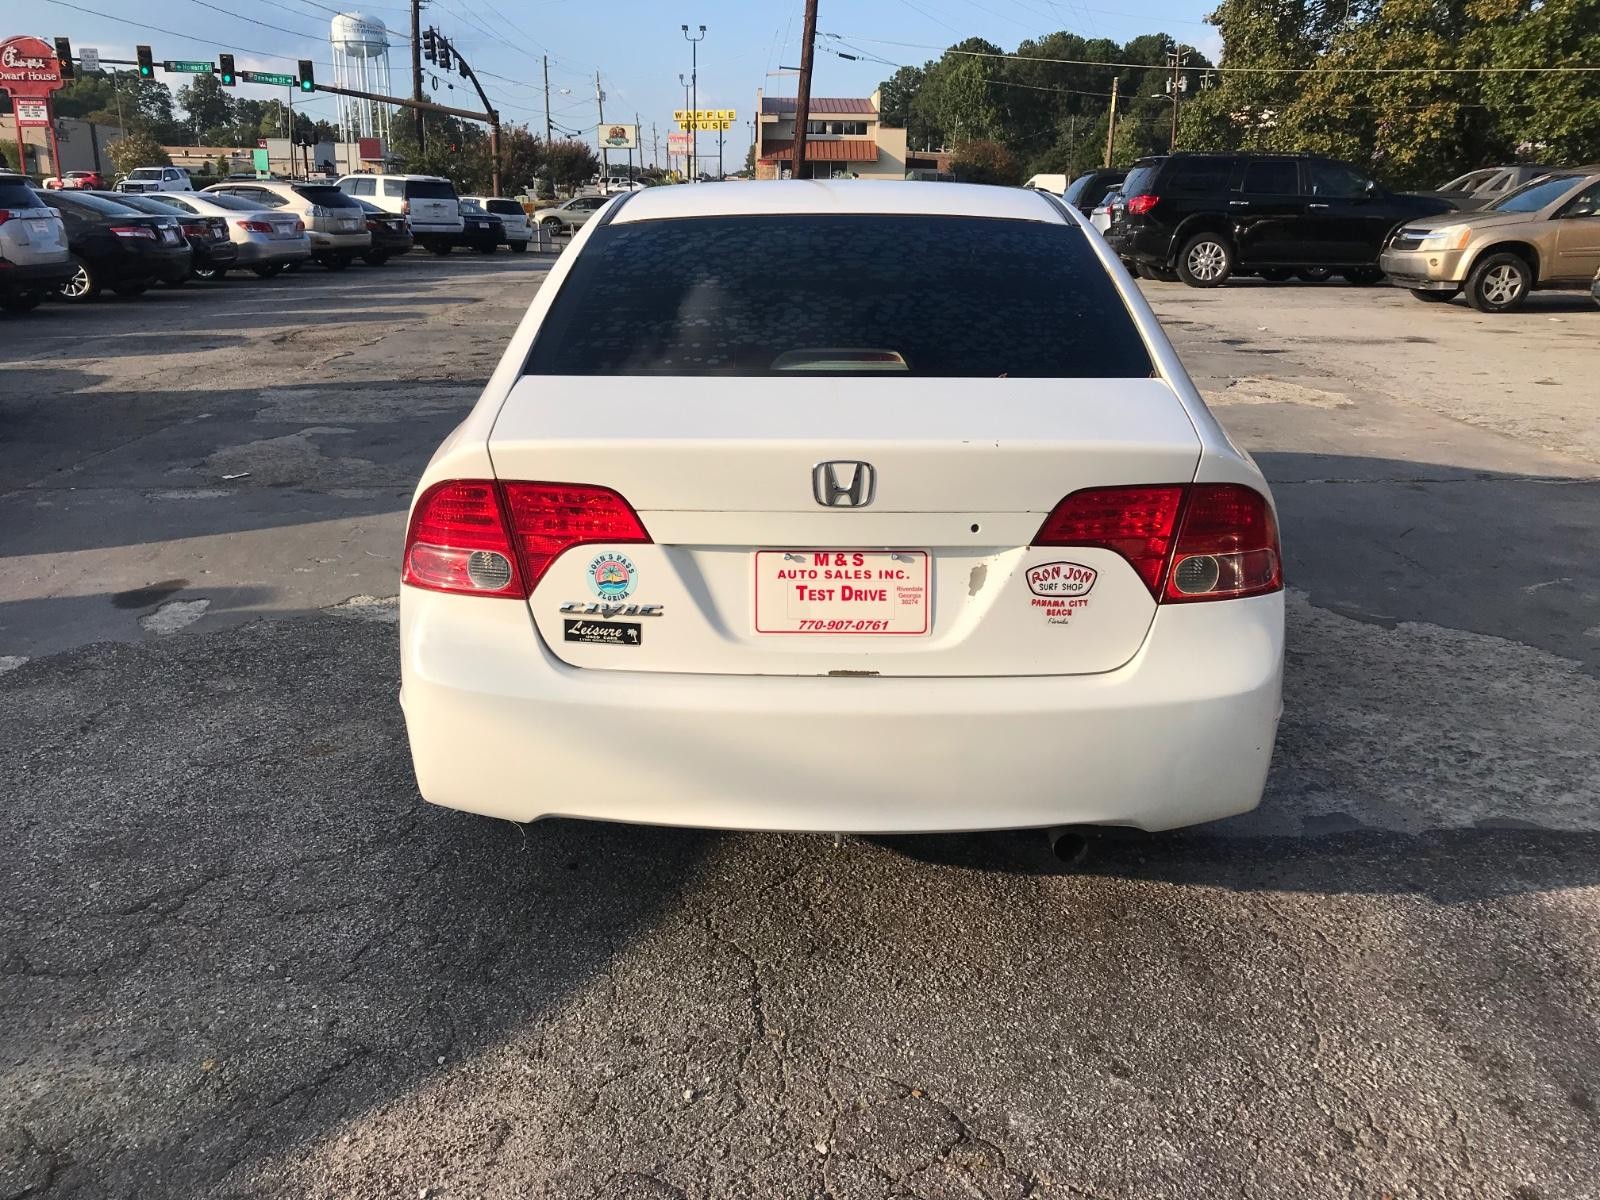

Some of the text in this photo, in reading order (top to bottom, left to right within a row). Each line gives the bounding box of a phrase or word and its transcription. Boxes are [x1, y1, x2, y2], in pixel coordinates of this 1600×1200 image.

[182, 63, 204, 71] Howard
[28, 72, 57, 81] House
[675, 111, 735, 119] WAFFLE
[680, 122, 729, 130] HOUSE
[616, 554, 635, 575] PASS
[814, 553, 864, 567] M & S
[777, 569, 910, 580] AUTO SALES INC.
[1032, 566, 1093, 584] RON JON
[1039, 582, 1083, 591] SURF SHOP
[597, 591, 630, 602] FLORIDA
[796, 585, 887, 602] TEST DRIVE
[898, 592, 922, 600] Georgia
[1031, 598, 1088, 607] PANAMA CITY
[559, 601, 664, 619] CIVIC
[568, 621, 623, 636] Leisure
[798, 620, 889, 631] 770-907-0761
